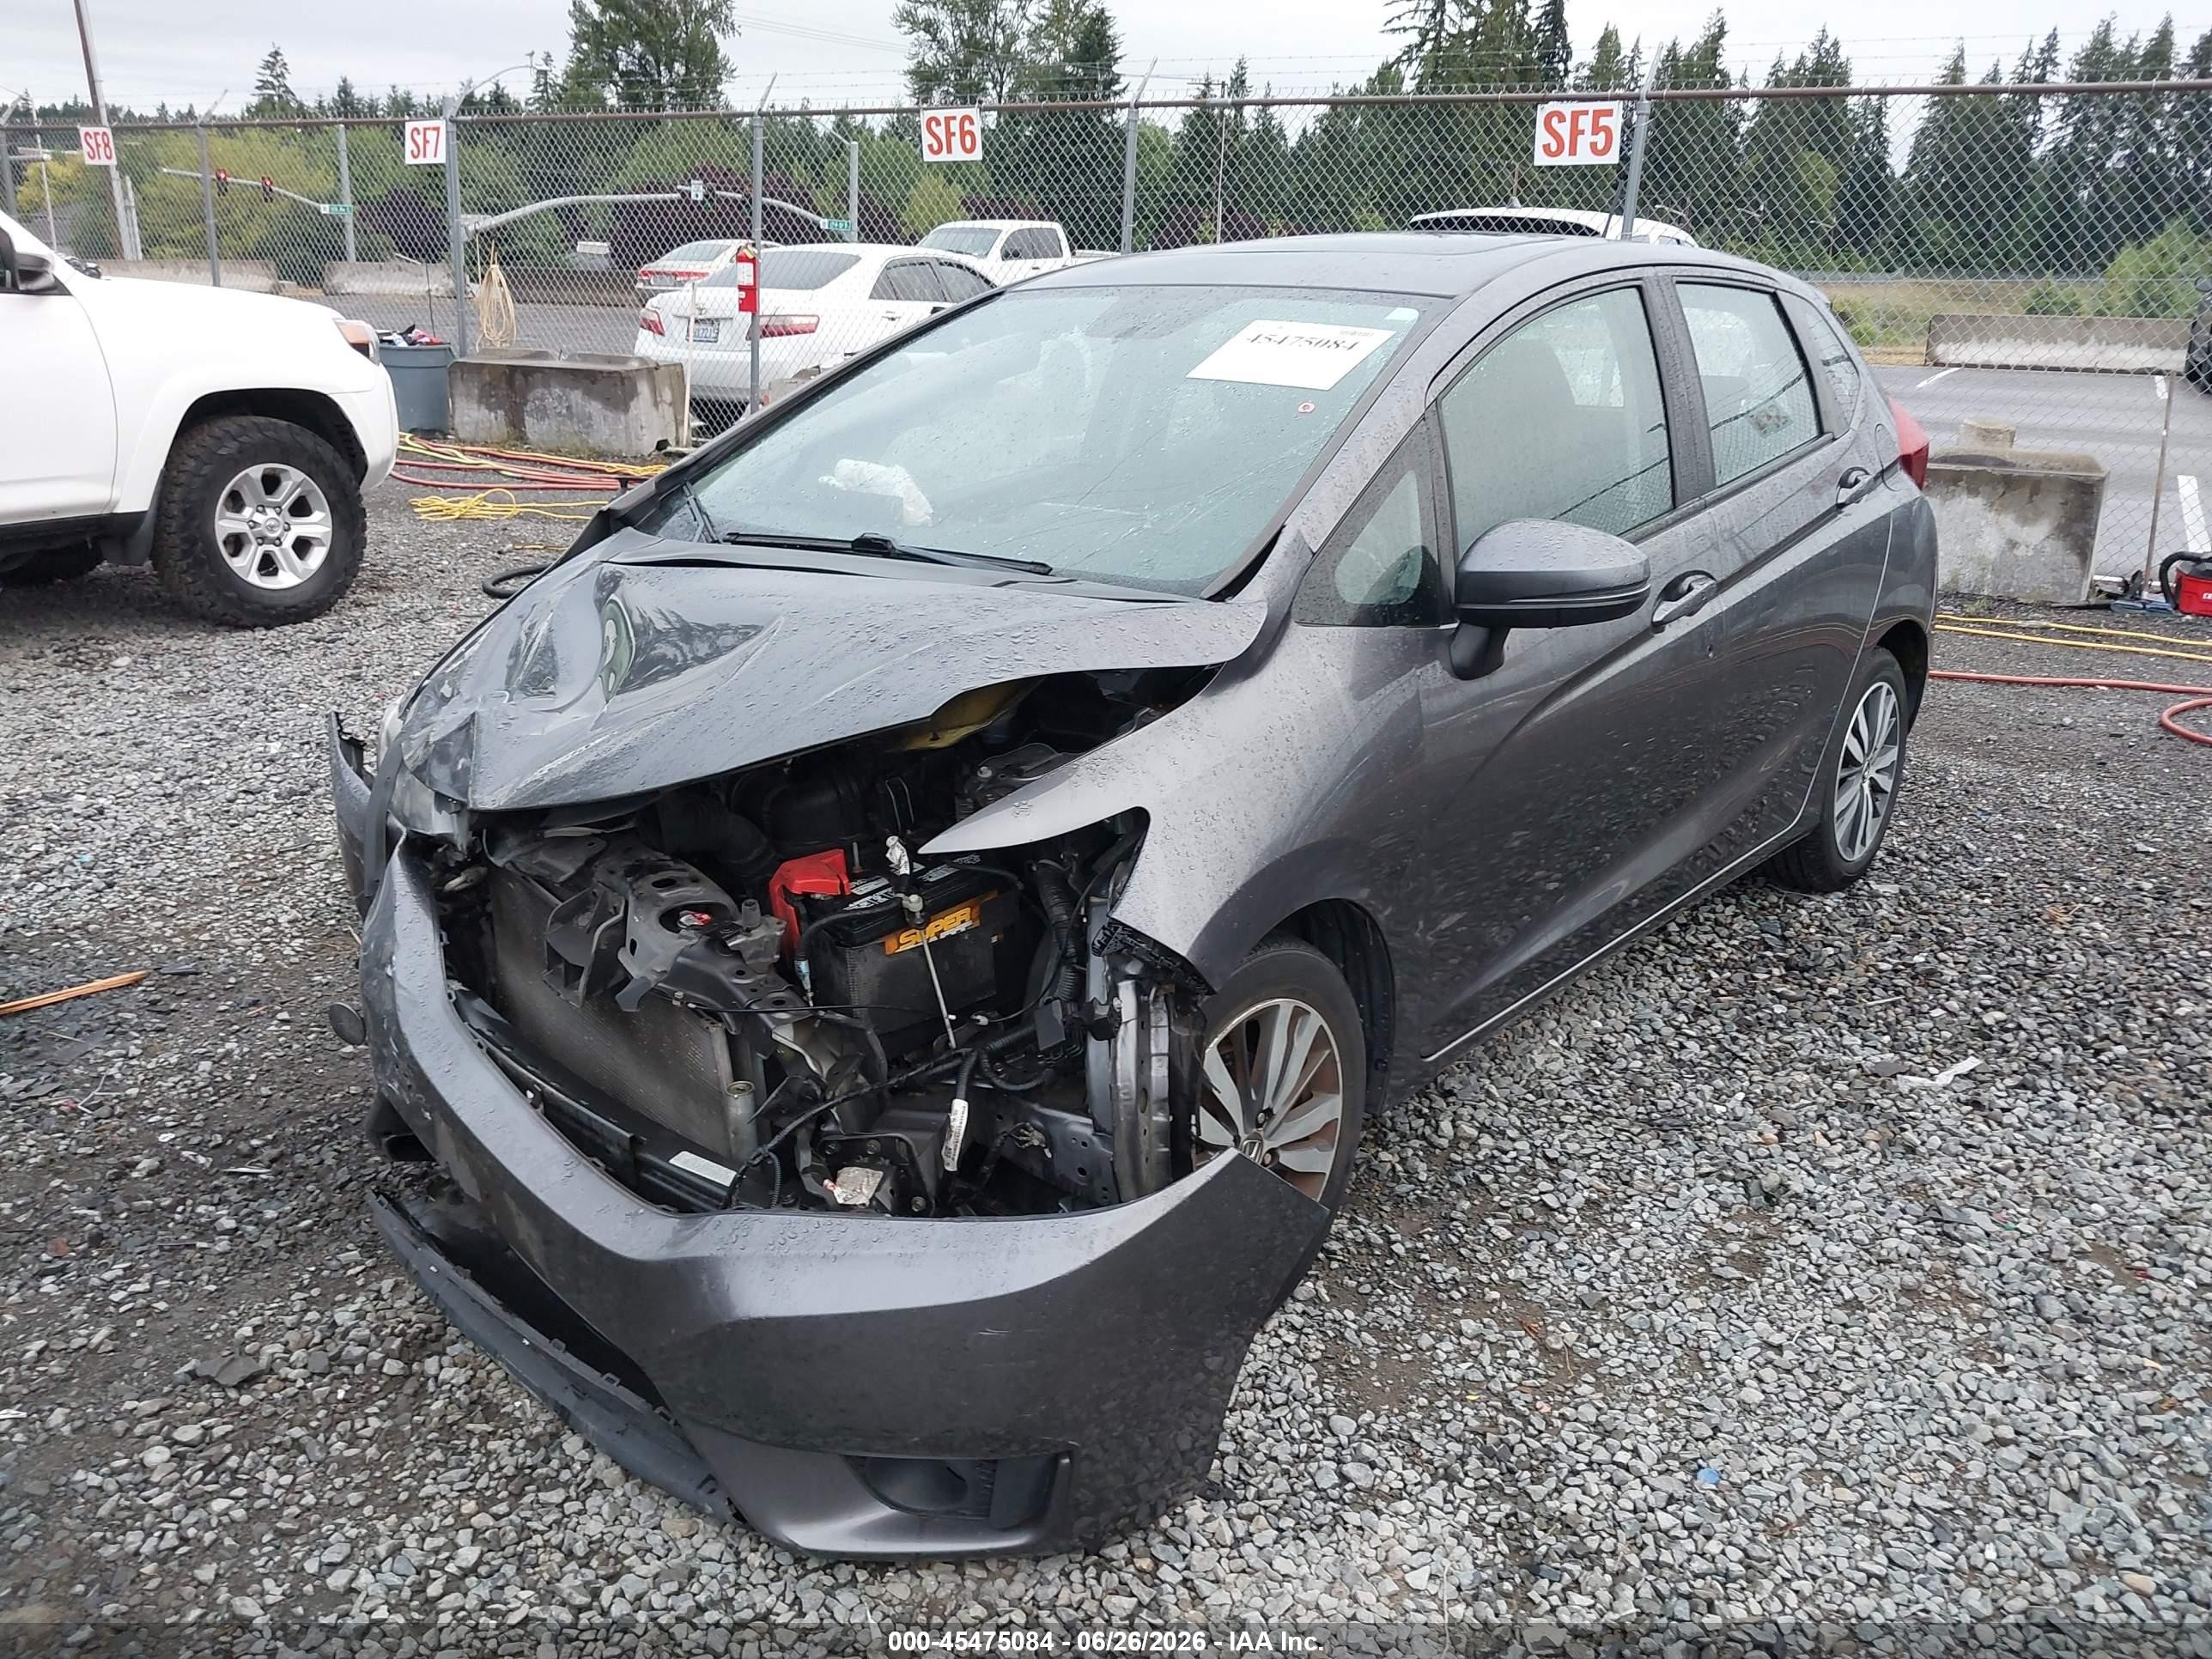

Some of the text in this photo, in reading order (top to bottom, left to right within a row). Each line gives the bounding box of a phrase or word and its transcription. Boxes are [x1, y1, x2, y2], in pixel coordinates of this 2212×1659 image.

[83, 131, 112, 161] SF8
[410, 125, 441, 160] SF7
[926, 114, 977, 155] SF6
[1541, 108, 1614, 158] SF5
[1246, 333, 1360, 351] 45475084
[898, 907, 972, 945] SUPER
